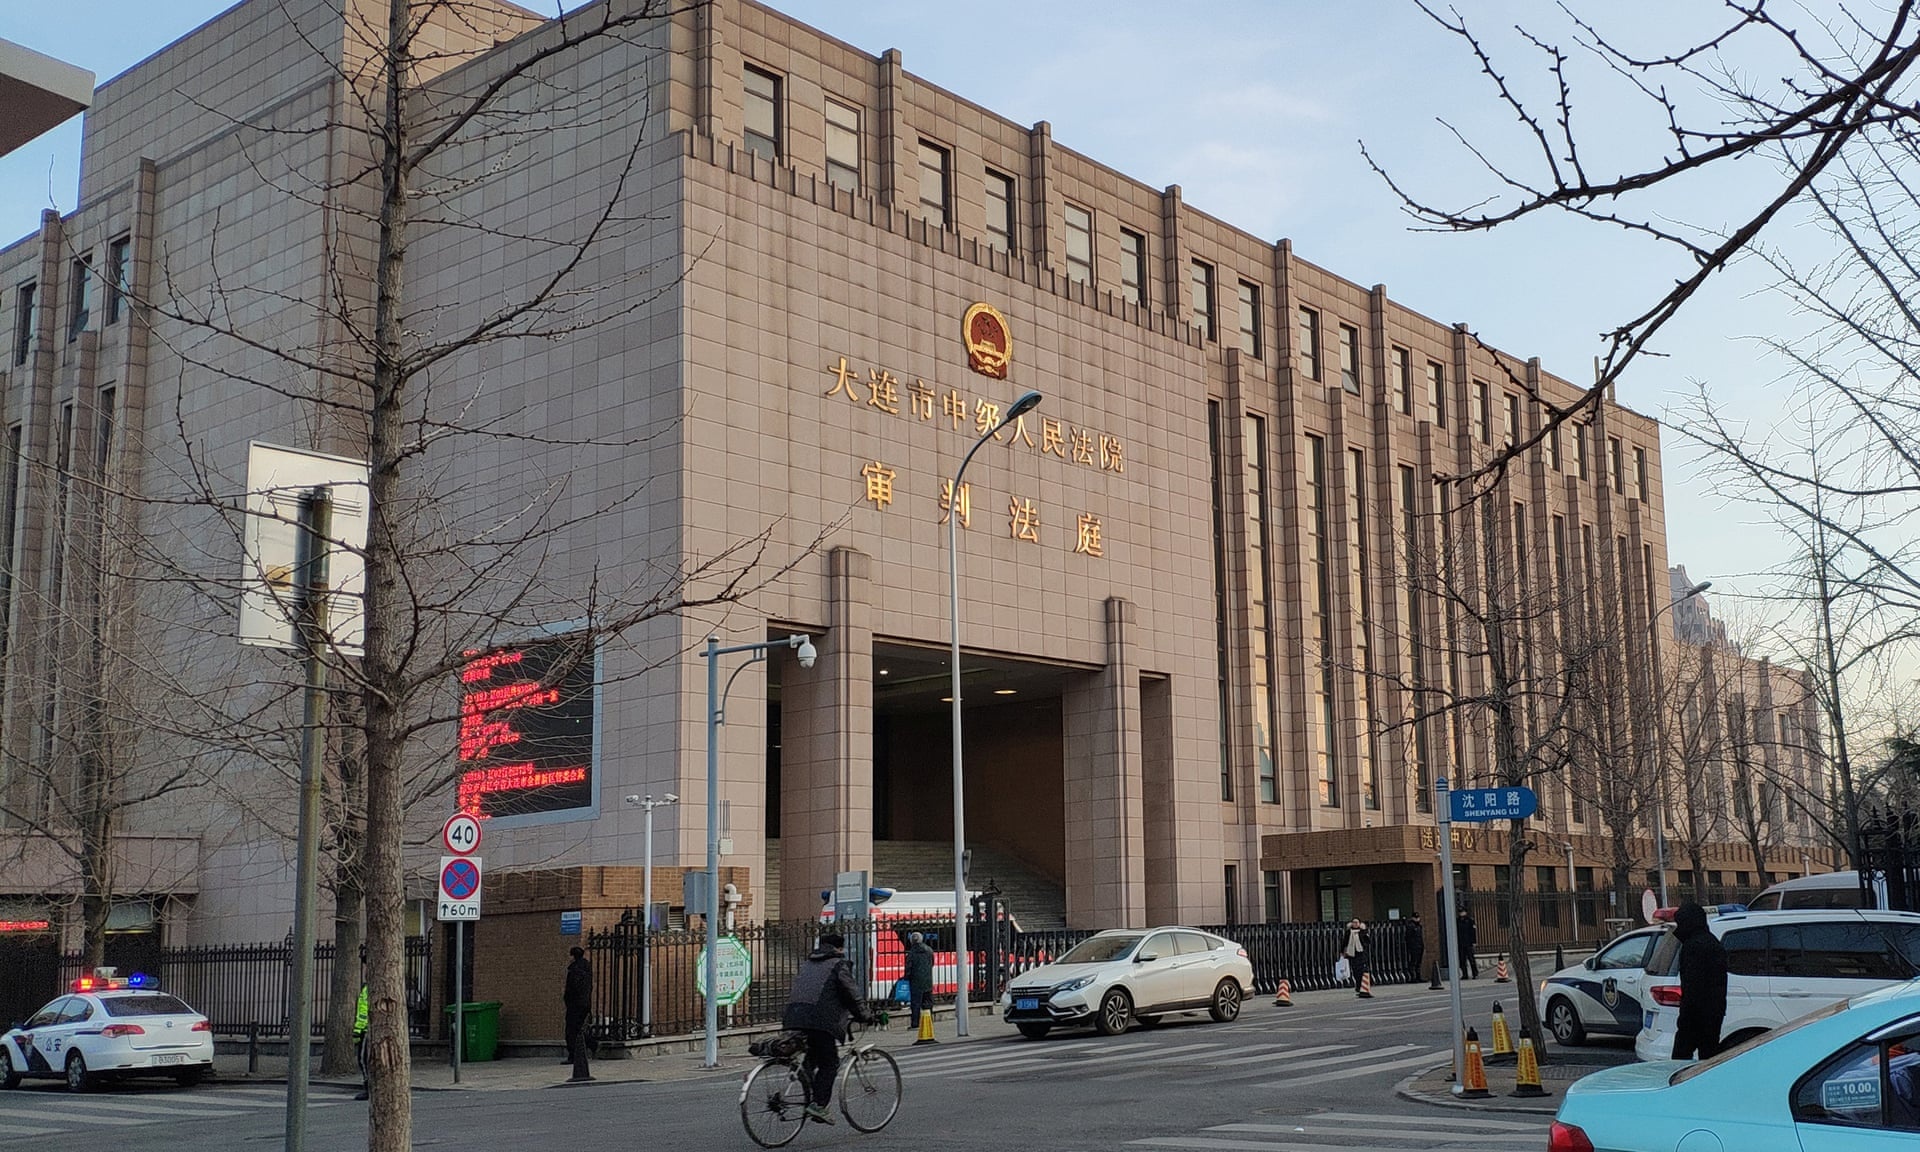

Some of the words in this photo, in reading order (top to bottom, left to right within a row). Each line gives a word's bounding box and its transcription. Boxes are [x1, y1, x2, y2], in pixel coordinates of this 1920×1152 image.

[825, 357, 1123, 472] 大连市中级人民法院
[862, 462, 1103, 556] 审判法庭
[1462, 792, 1519, 808] 沈阳路
[1465, 809, 1506, 817] SHENYANG
[453, 826, 473, 844] 40
[451, 904, 477, 916] 60m
[1843, 1082, 1871, 1094] 10.00
